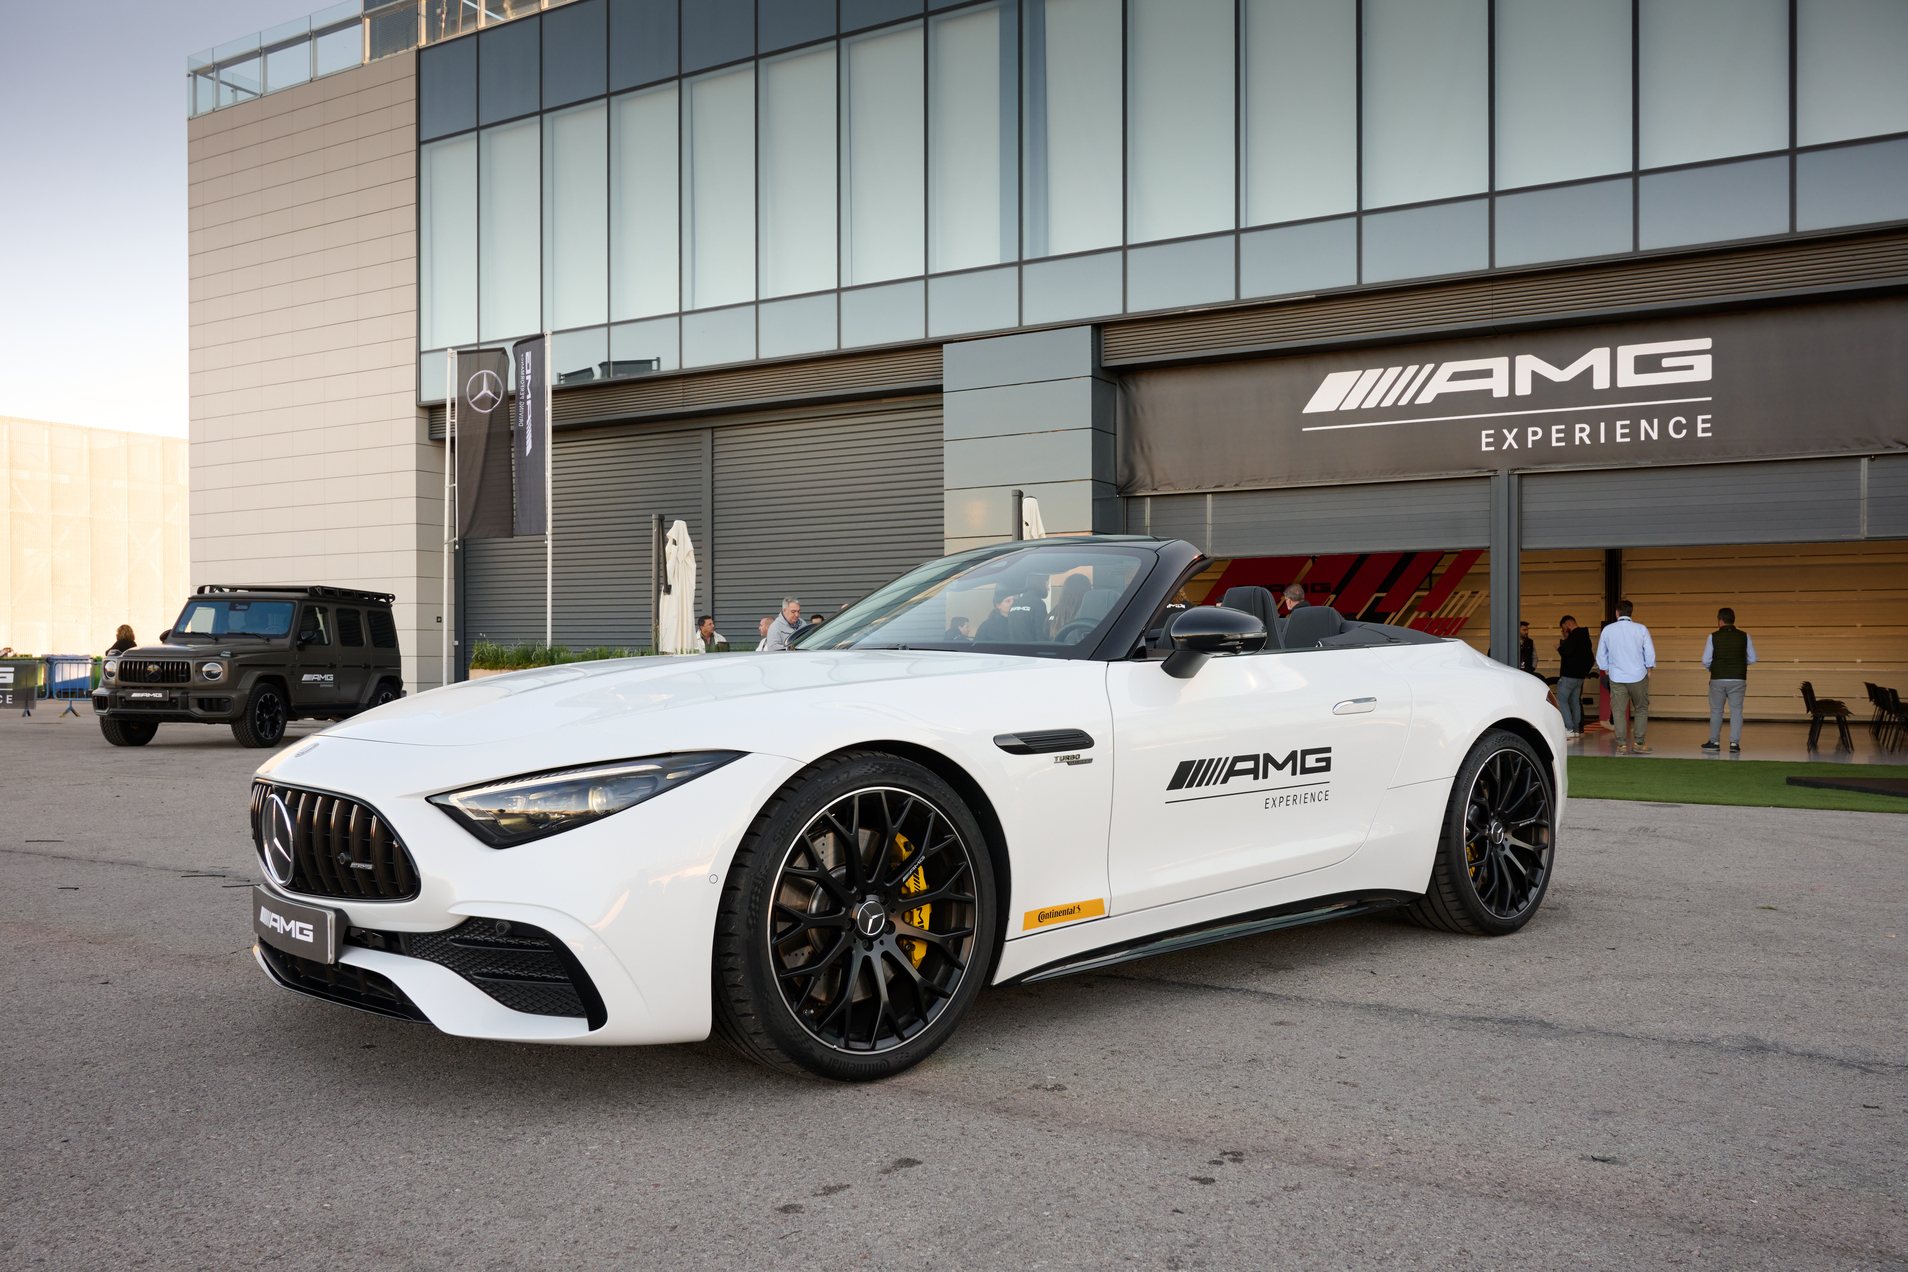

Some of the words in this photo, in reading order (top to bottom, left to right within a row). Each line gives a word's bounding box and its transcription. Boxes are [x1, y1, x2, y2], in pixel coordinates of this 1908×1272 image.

[1415, 337, 1712, 404] AMG
[1481, 414, 1712, 451] EXPERIENCE
[312, 673, 333, 681] AMG
[1220, 746, 1331, 784] AMG
[772, 775, 842, 845] SportContact
[1264, 789, 1329, 810] EXPERIENCE
[268, 912, 314, 943] AMG
[1037, 905, 1076, 923] Continental
